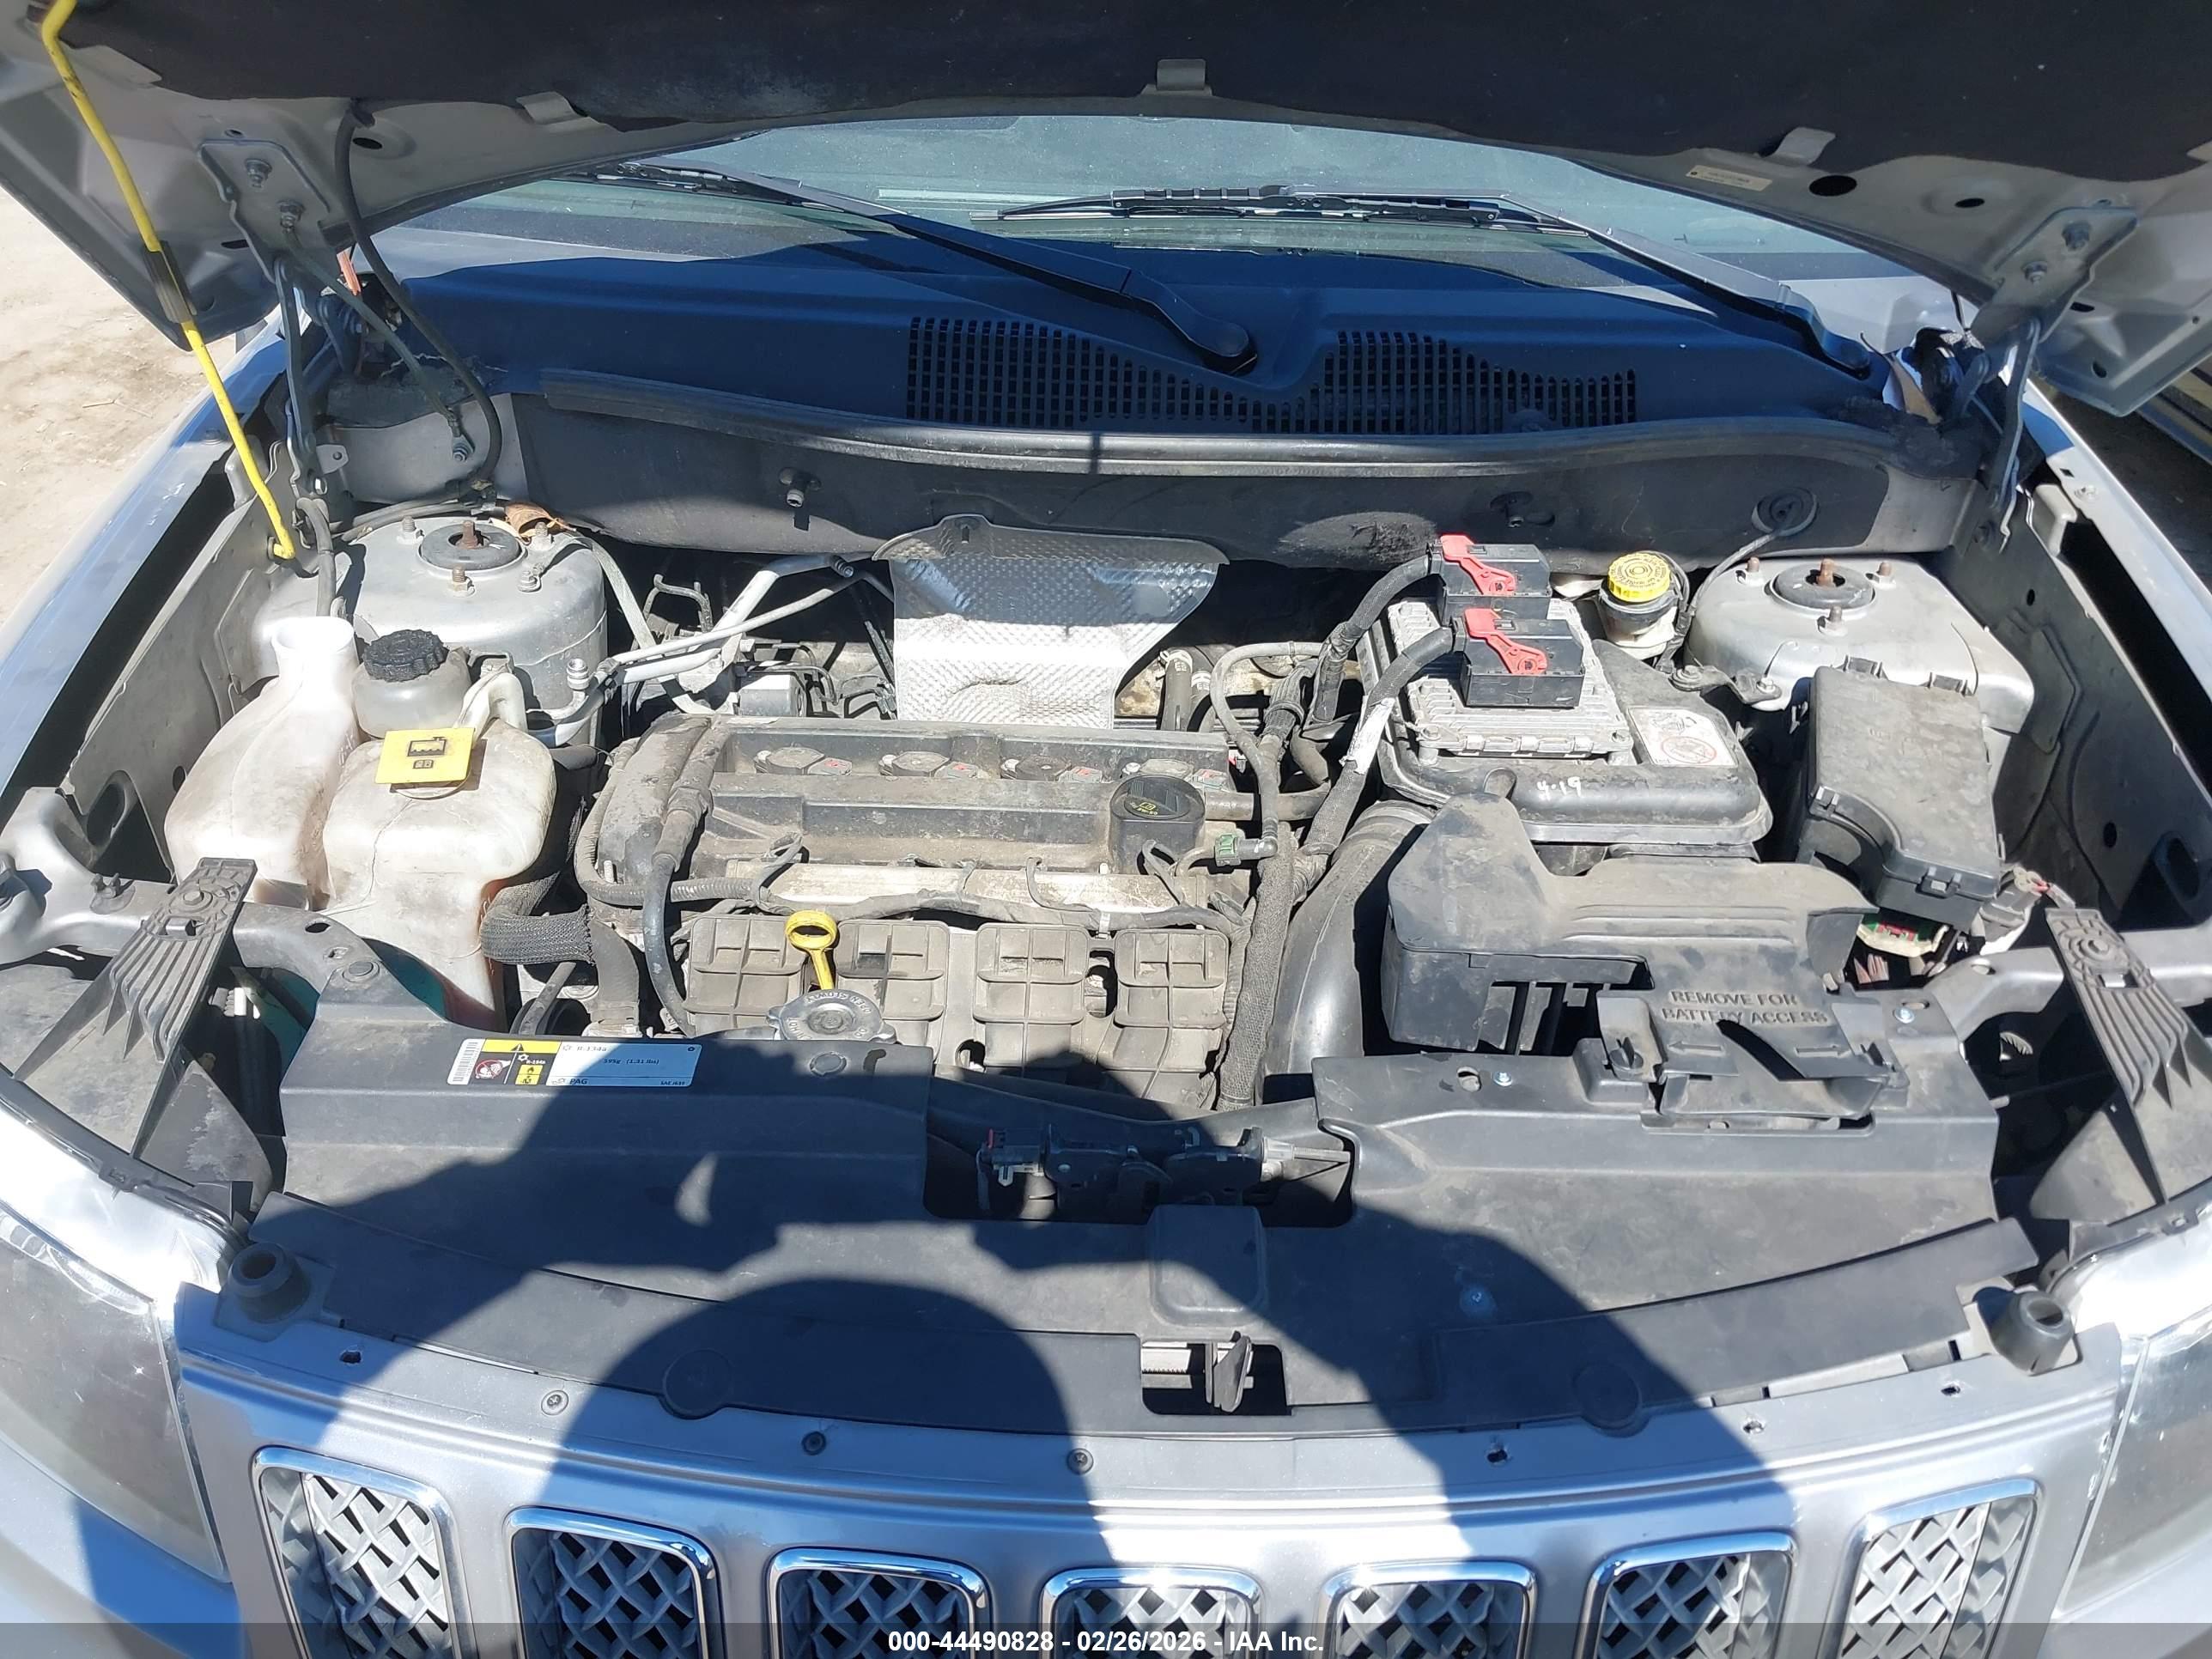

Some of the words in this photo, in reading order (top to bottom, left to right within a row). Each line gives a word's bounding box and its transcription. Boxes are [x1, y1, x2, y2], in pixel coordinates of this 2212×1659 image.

[1669, 990, 1754, 1006] REMOVE
[1756, 994, 1797, 1006] FOR
[1662, 1007, 1743, 1024] BATTERY
[1751, 1011, 1828, 1024] ACCESS
